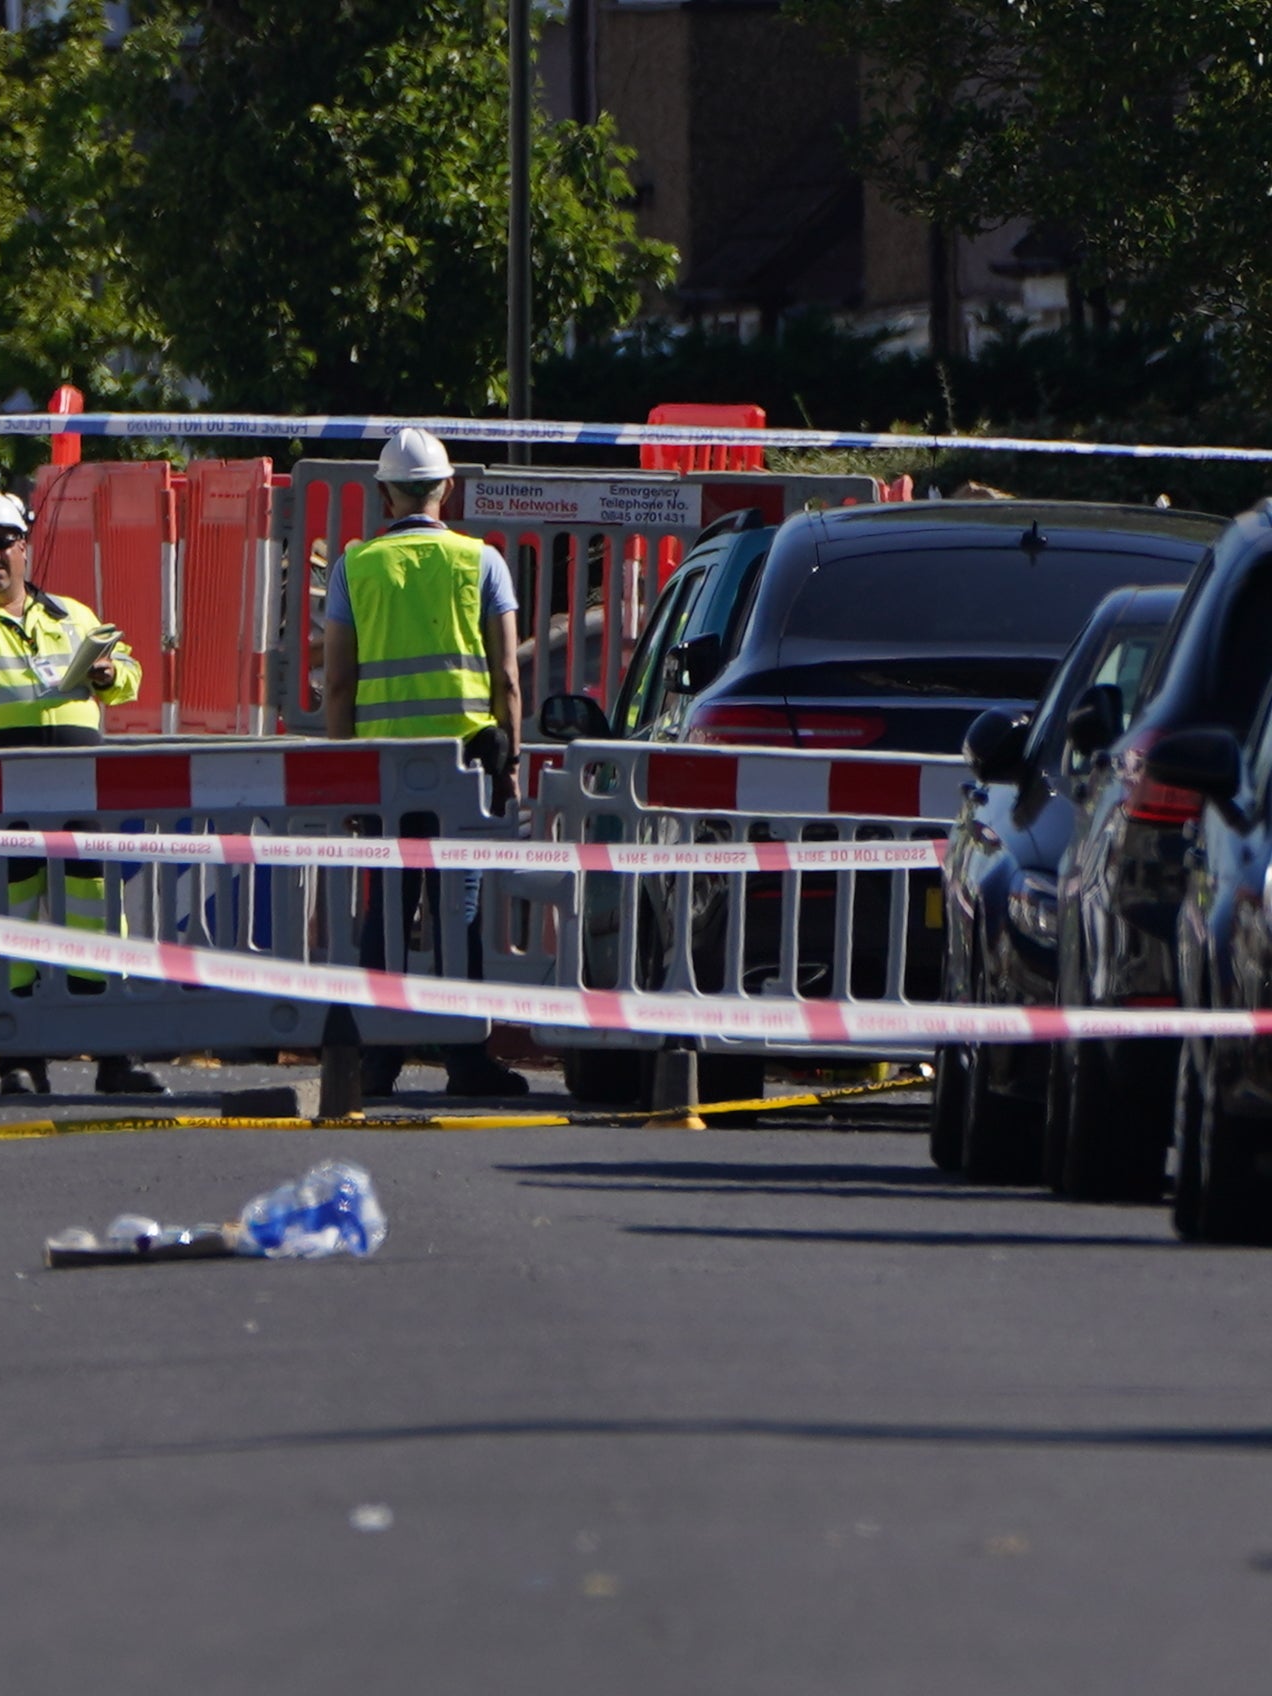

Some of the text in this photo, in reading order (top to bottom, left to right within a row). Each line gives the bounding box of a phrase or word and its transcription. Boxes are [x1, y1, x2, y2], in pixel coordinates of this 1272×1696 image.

[476, 483, 544, 497] Southern
[609, 484, 680, 499] Emergency
[475, 497, 579, 513] Gas Networks
[599, 497, 688, 511] Telephone No.
[601, 510, 685, 523] 0845 0701431
